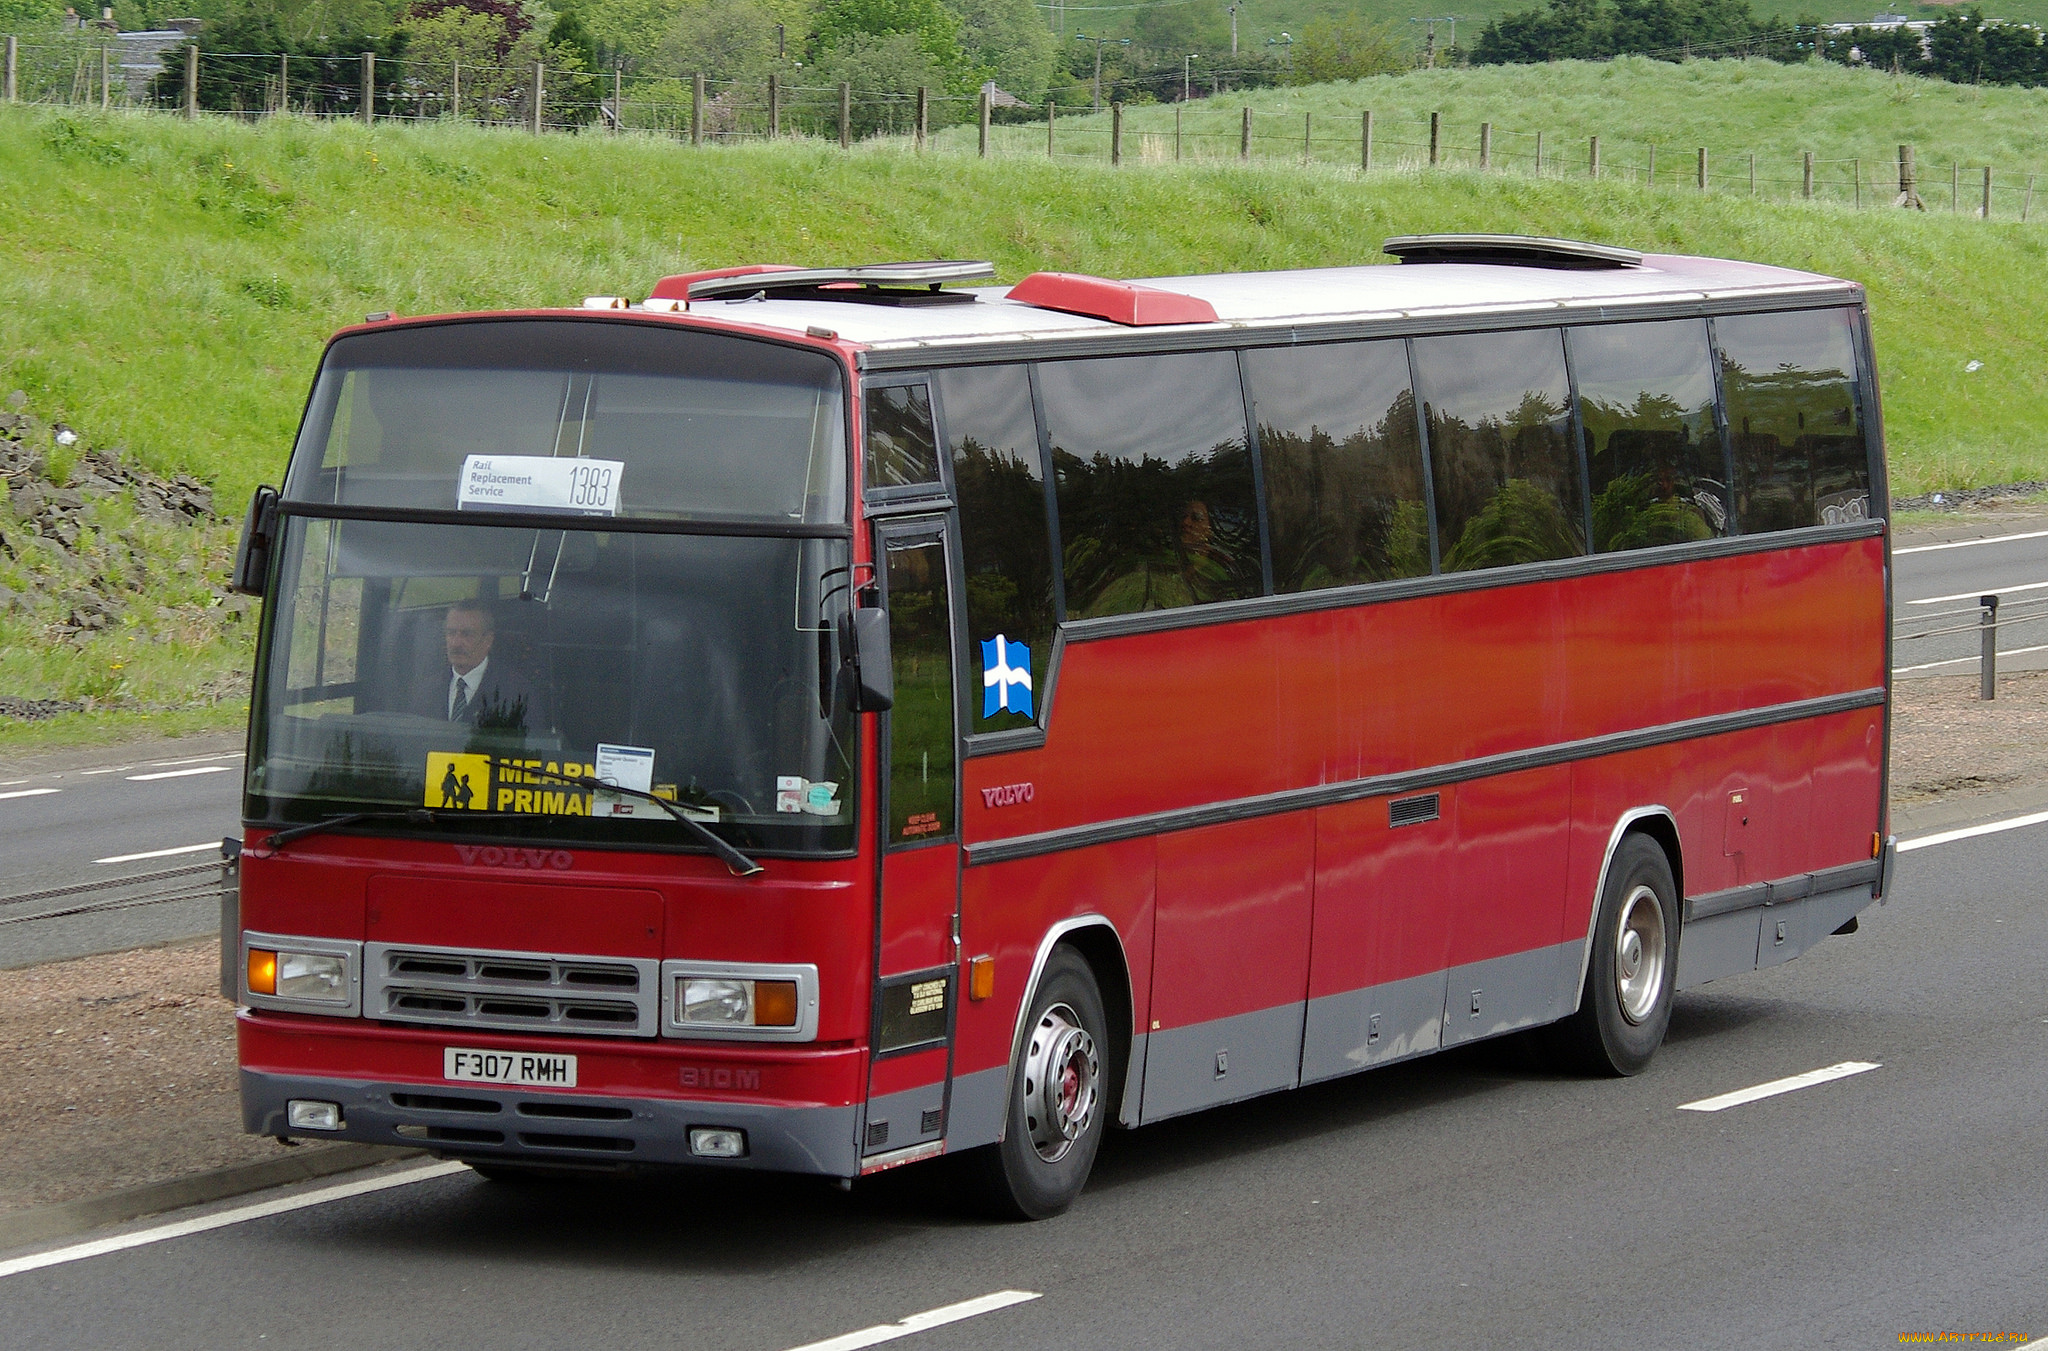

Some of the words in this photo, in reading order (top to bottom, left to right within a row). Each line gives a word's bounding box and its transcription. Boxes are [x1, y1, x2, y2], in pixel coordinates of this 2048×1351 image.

[470, 472, 532, 485] Replacement
[472, 460, 492, 471] Rail
[468, 485, 504, 497] Service
[569, 466, 612, 506] 1383
[982, 782, 1034, 808] VOLVO
[453, 844, 574, 870] VOLVO
[454, 1053, 513, 1079] F307
[521, 1057, 567, 1083] RMH
